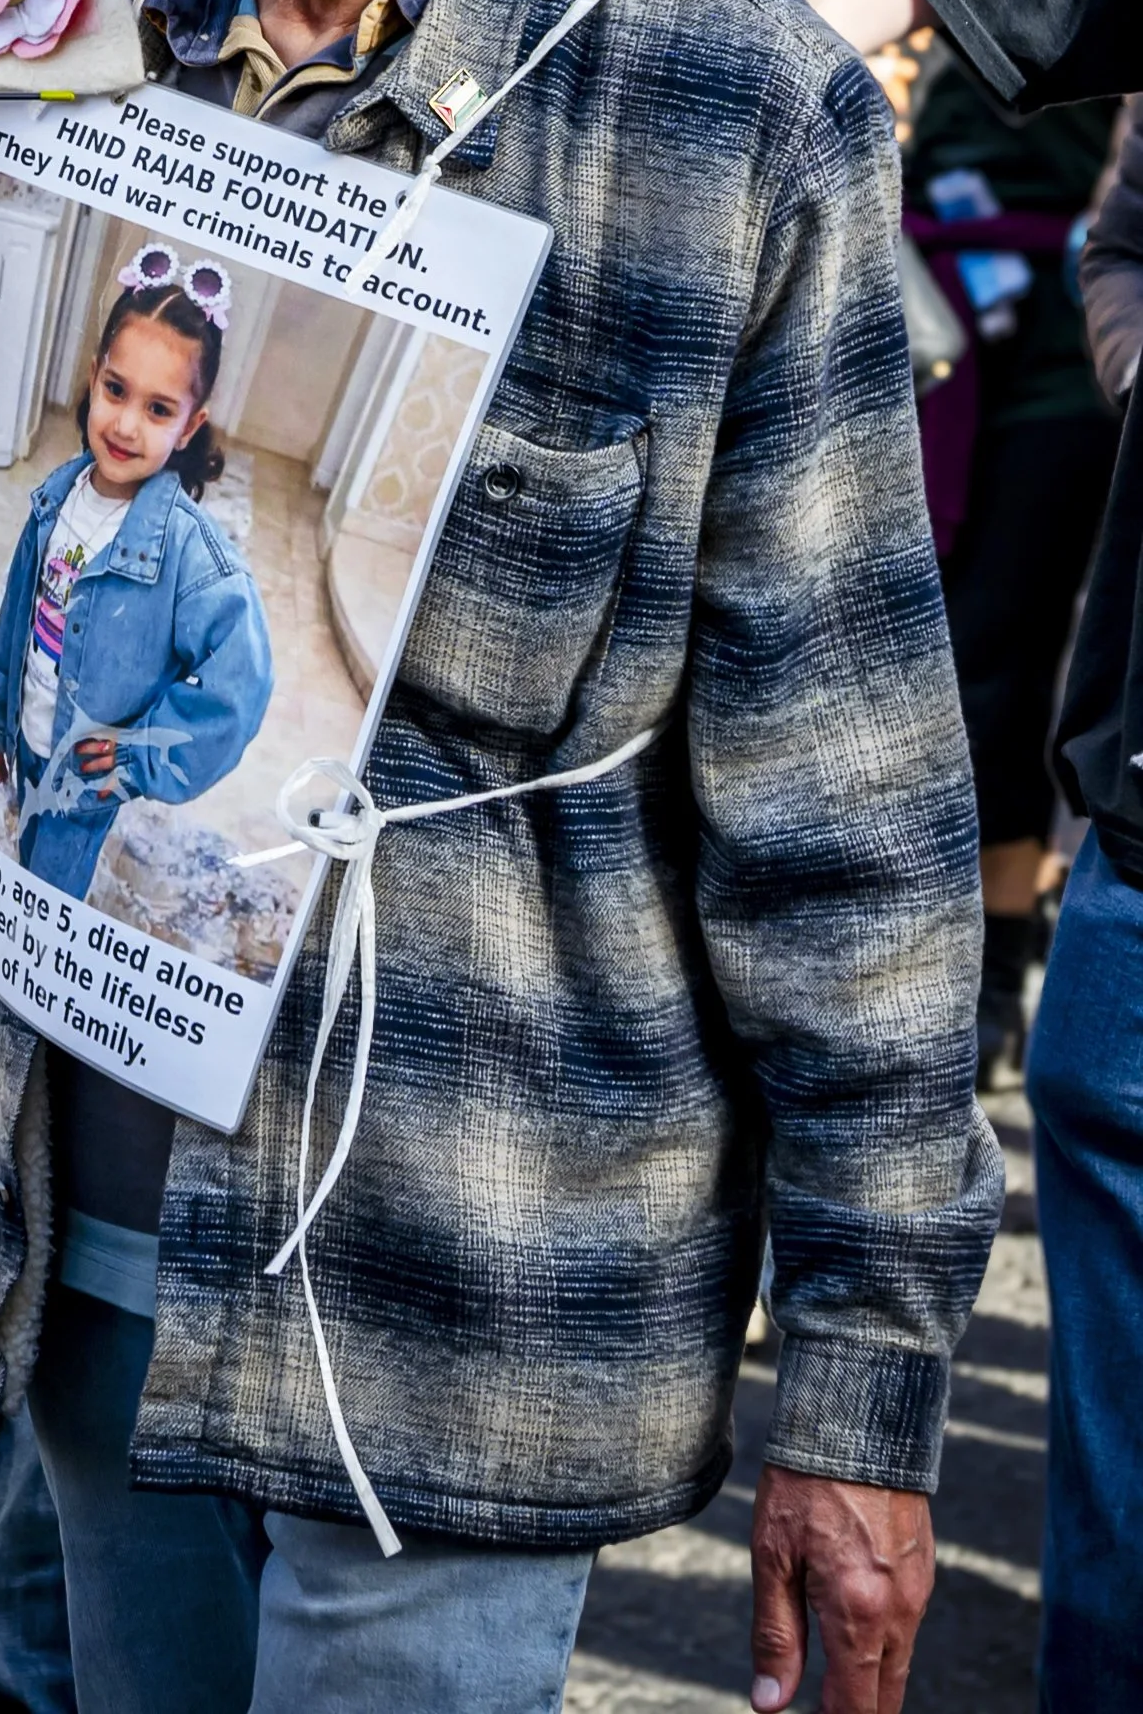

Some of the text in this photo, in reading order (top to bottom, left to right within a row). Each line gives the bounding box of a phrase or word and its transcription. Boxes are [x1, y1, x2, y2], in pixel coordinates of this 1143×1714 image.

[56, 117, 428, 274] HIND RAJAB FOUNDATIN.
[119, 101, 387, 218] Please support the
[58, 154, 119, 197] hold
[124, 184, 176, 218] war
[182, 206, 314, 270] criminals
[361, 272, 491, 336] account.
[1, 957, 20, 988] of
[22, 967, 58, 1014] her
[63, 996, 147, 1068] family.
[12, 880, 50, 921] age
[57, 903, 78, 942] 5,
[88, 923, 150, 973] died
[156, 960, 245, 1016] alone
[22, 923, 48, 969] by
[54, 946, 94, 991] the
[100, 971, 207, 1046] lifeless
